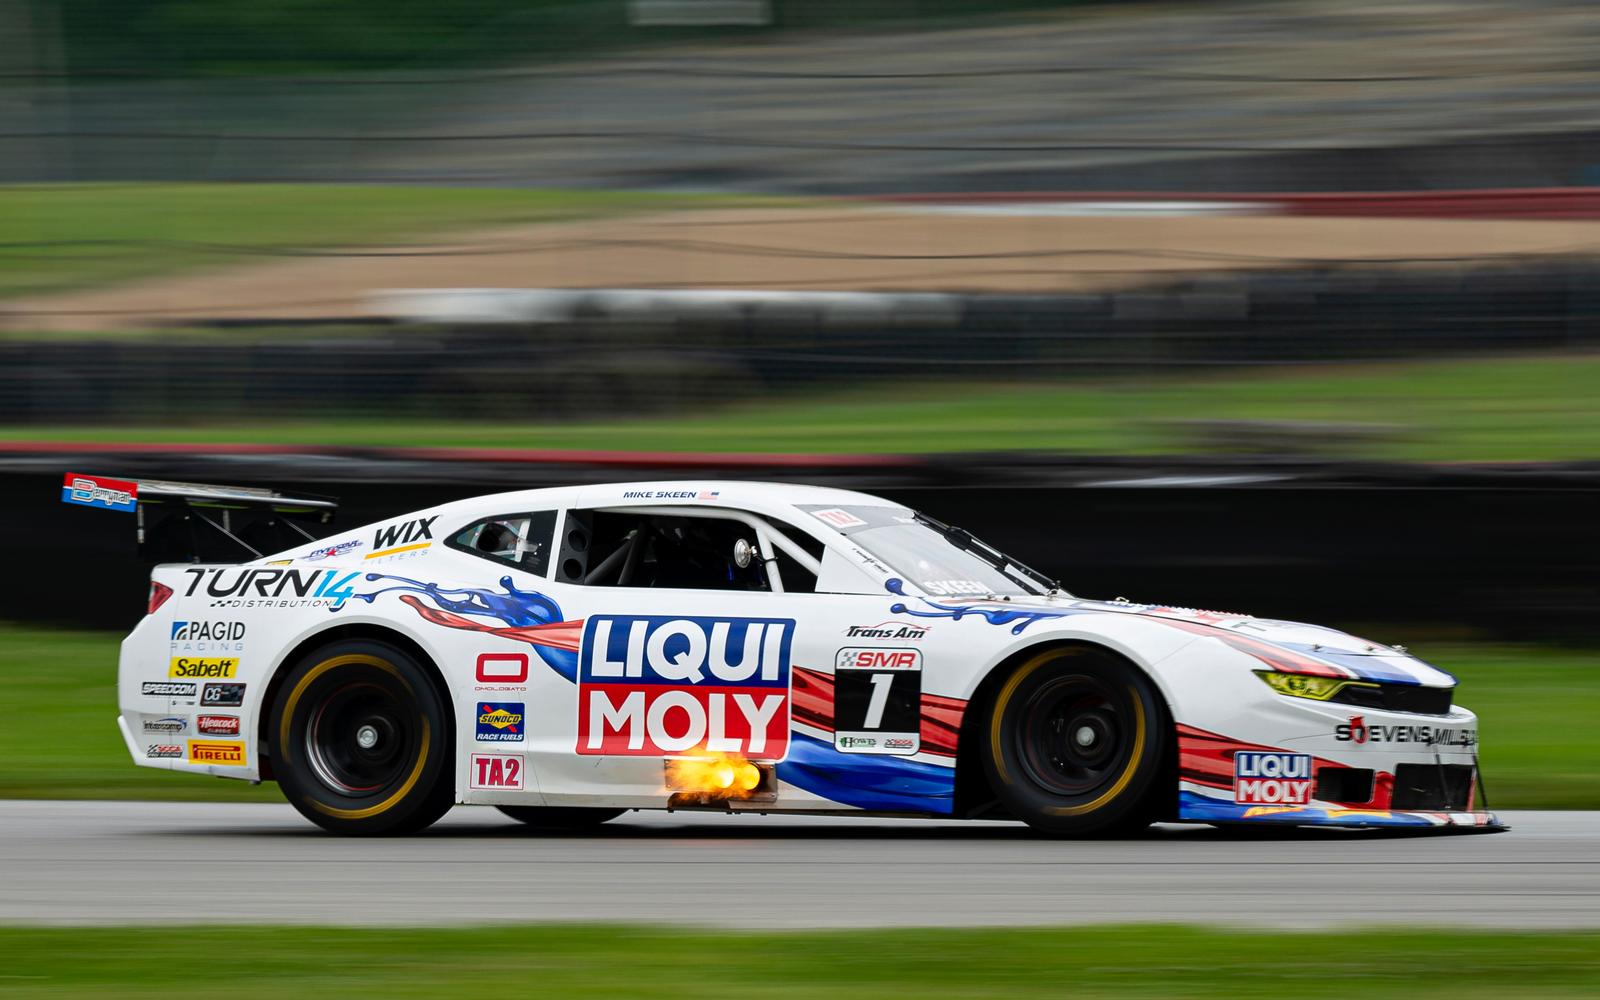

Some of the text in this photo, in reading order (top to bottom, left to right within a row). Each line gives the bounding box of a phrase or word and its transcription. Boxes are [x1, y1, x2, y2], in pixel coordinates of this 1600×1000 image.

[71, 478, 131, 505] Berryman
[373, 515, 440, 550] WIX
[231, 600, 333, 608] DISTRIBUTION
[189, 621, 246, 641] PAGID
[846, 626, 926, 639] Trans Am
[170, 642, 244, 651] RACING
[591, 619, 786, 684] LIQUI
[175, 658, 232, 678] Sabelt
[856, 652, 916, 668] SMR
[142, 683, 196, 695] SPEEDCOM
[863, 673, 895, 729] 1
[201, 717, 238, 729] Heacock
[481, 714, 520, 724] SUNOCO
[587, 690, 786, 754] MOLY
[476, 733, 499, 741] RACE
[192, 744, 241, 760] PIRELLI
[476, 758, 519, 786] TA2
[1239, 755, 1308, 778] LIQUI
[1238, 780, 1310, 802] MOLY
